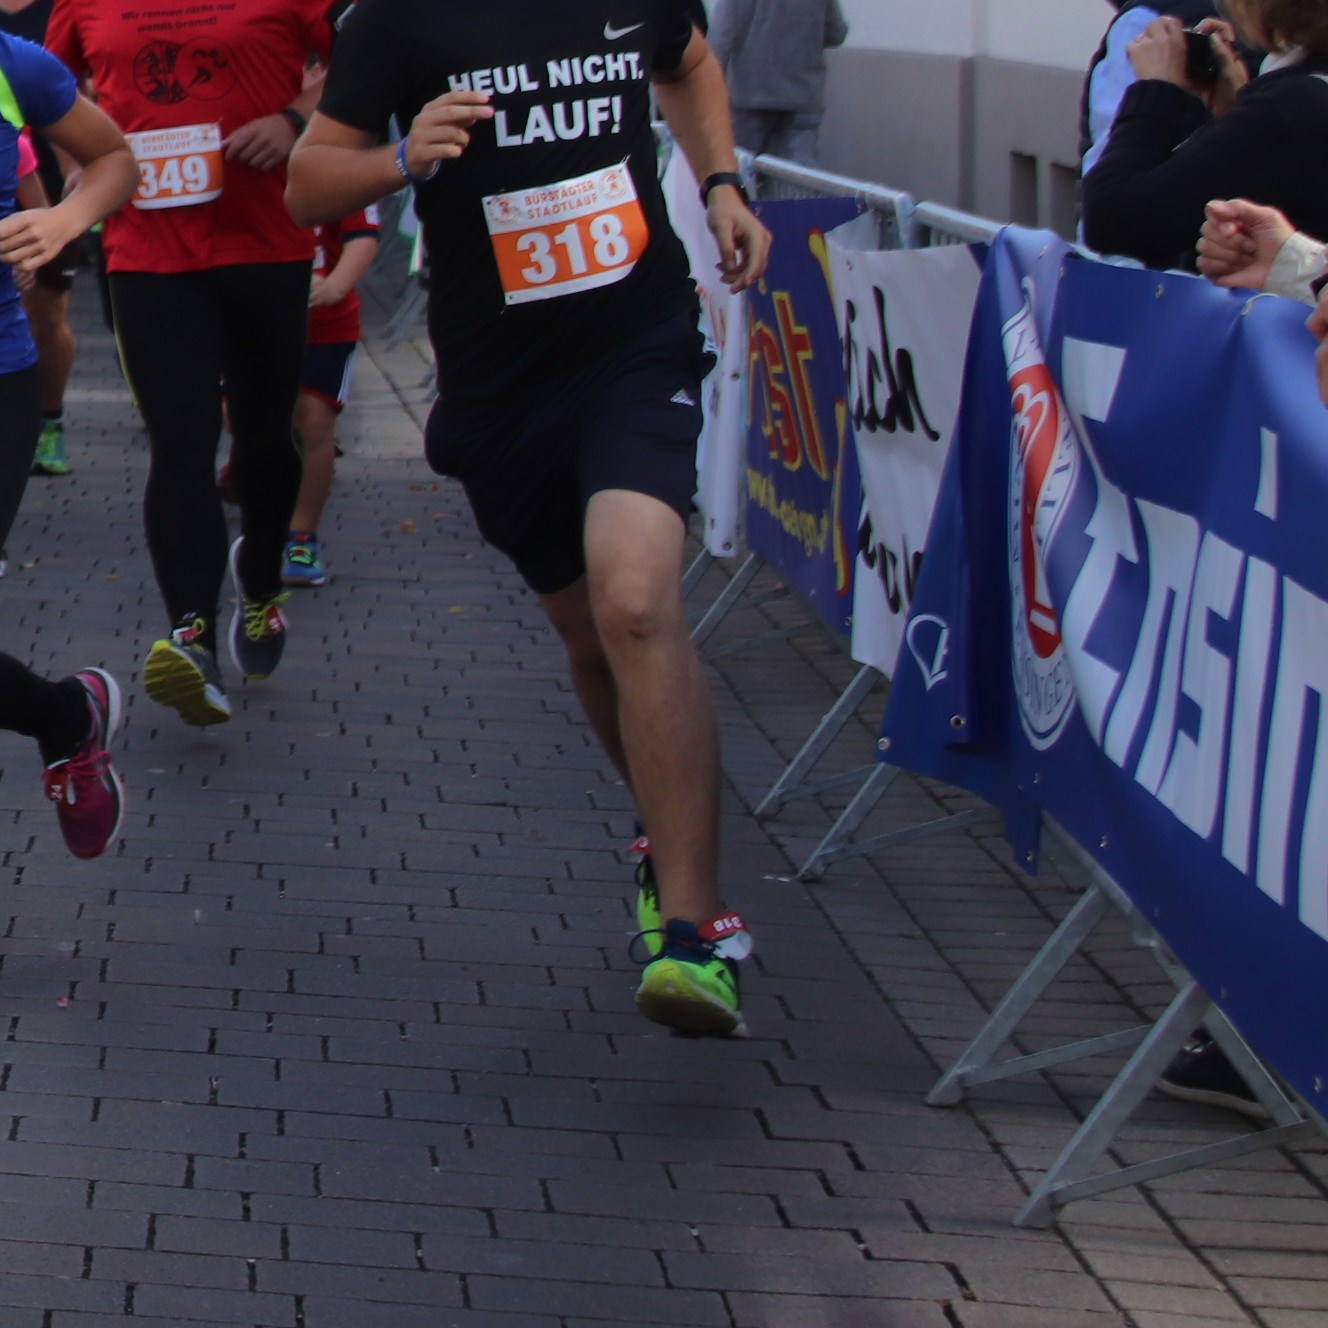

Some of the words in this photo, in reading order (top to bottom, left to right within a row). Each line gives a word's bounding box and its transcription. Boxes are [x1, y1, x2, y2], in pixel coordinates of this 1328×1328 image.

[448, 63, 539, 98] HEUL
[495, 94, 623, 148] LAUF!
[138, 153, 211, 199] 349
[524, 179, 596, 207] BÜRSTÄDTER
[526, 194, 599, 220] STADTLAUF
[516, 212, 631, 285] 318
